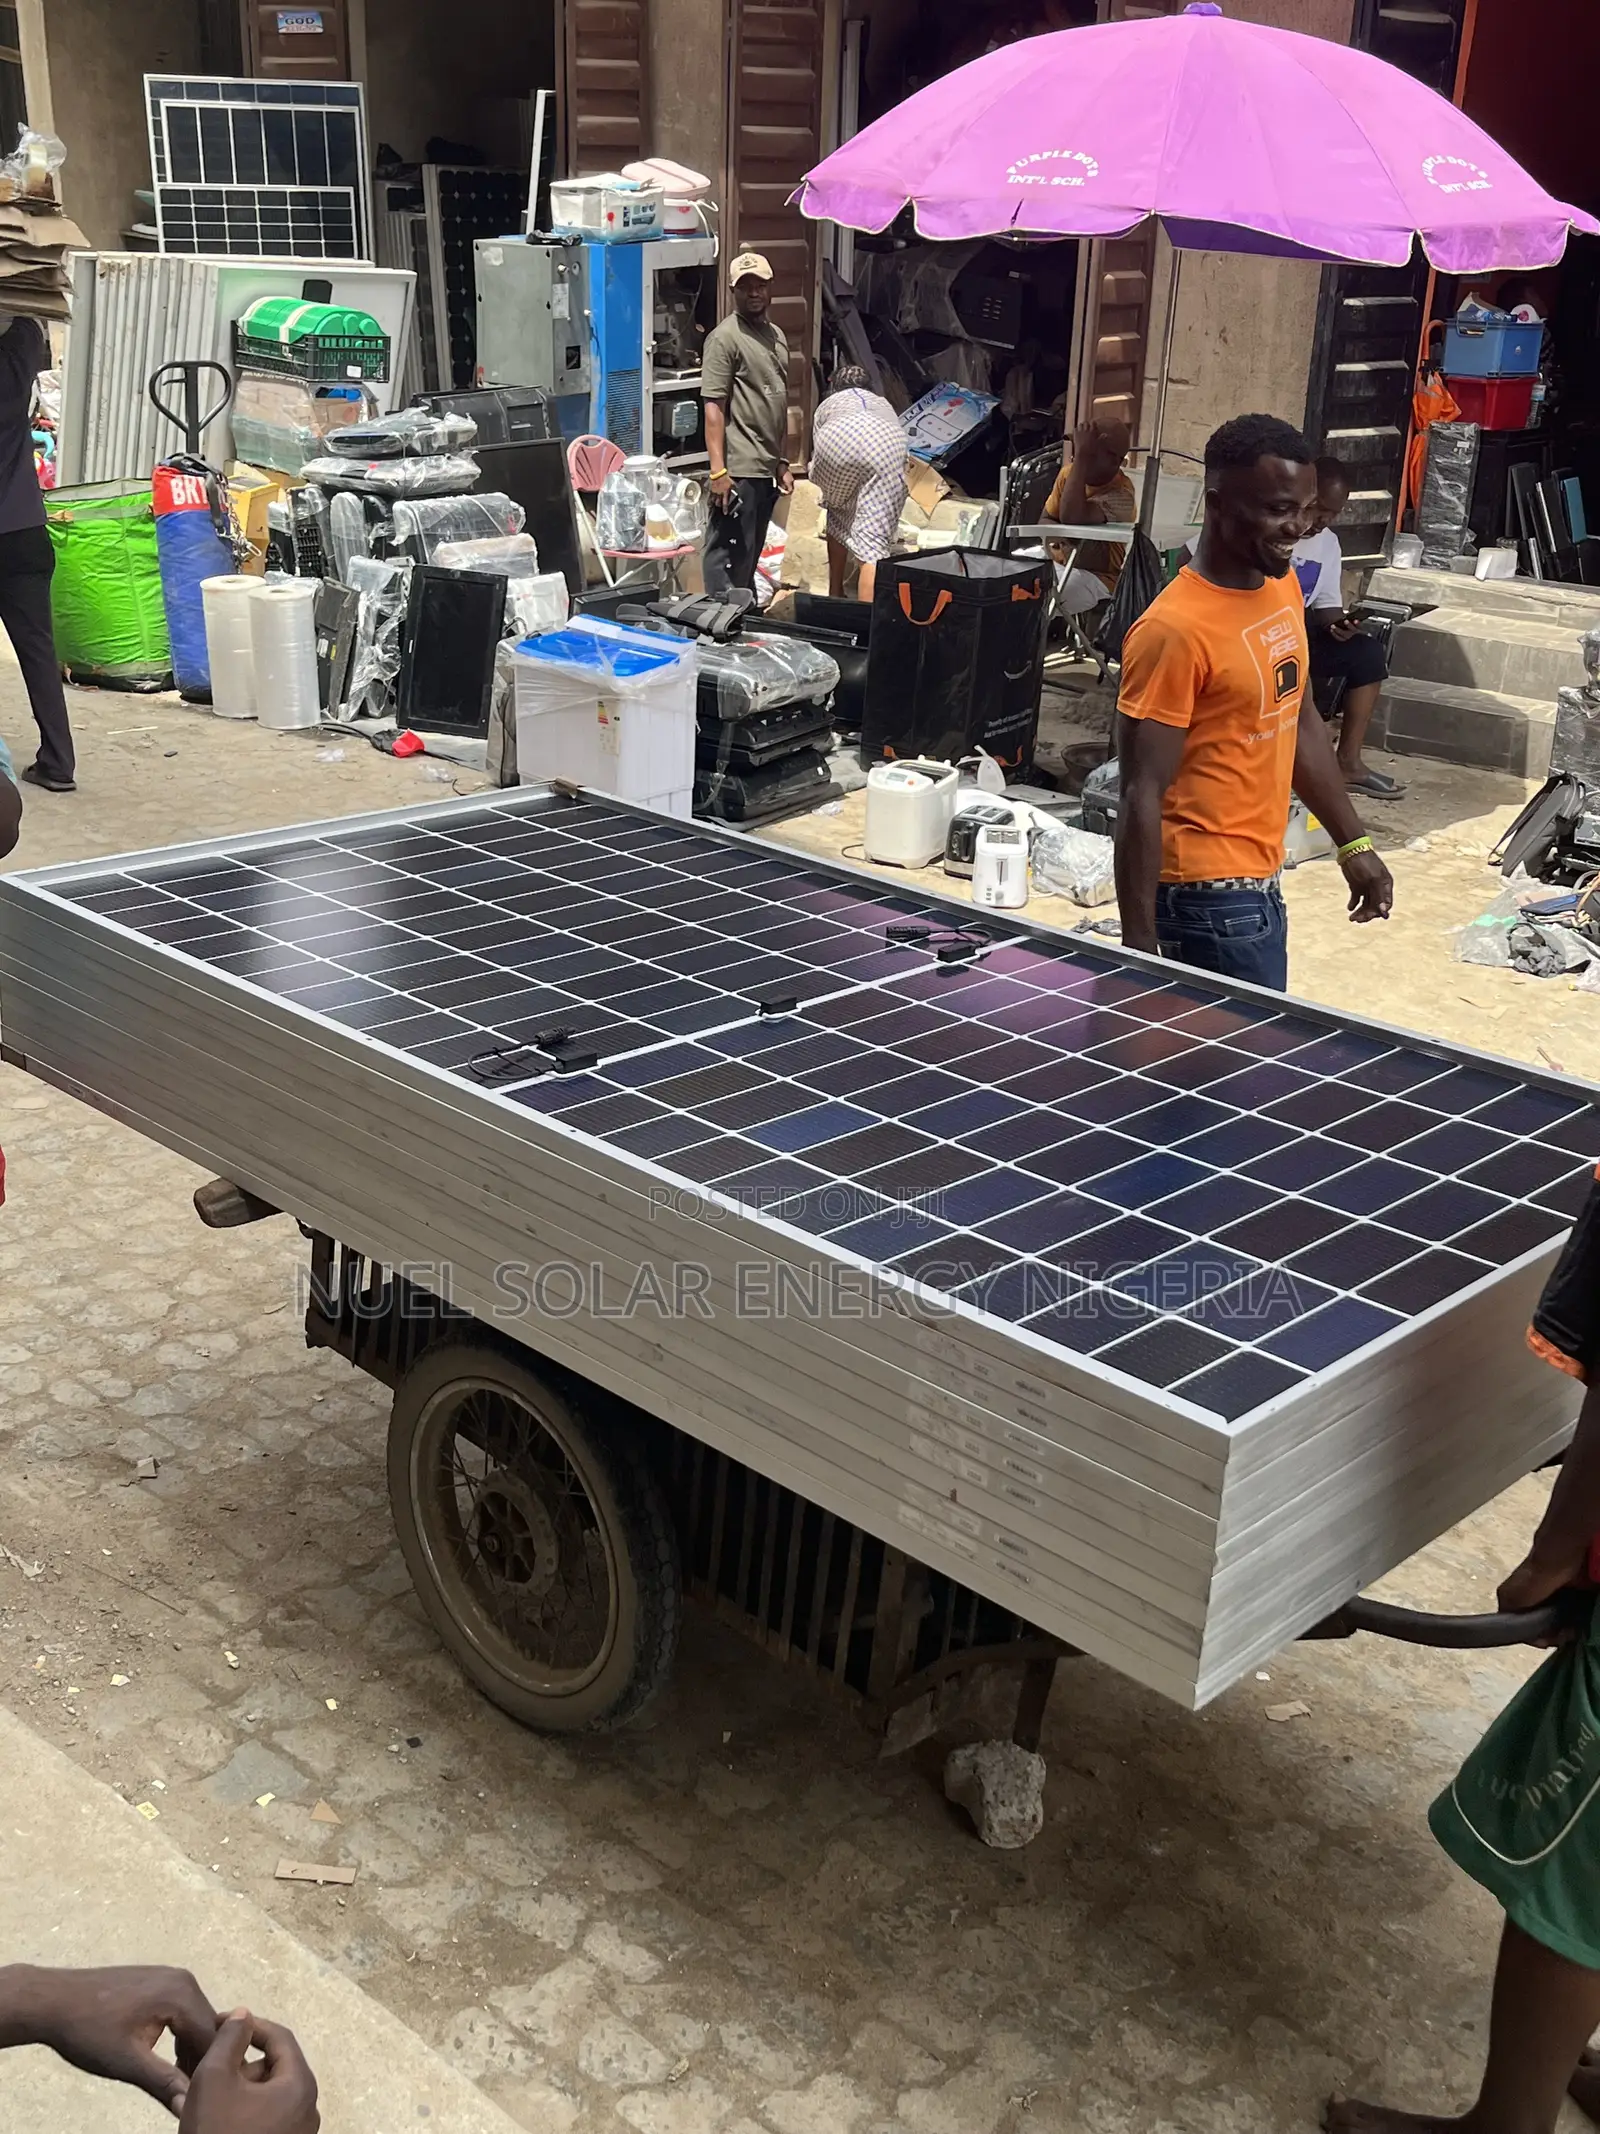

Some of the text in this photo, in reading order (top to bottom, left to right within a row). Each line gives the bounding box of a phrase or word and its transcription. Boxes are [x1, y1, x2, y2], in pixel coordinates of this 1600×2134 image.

[285, 17, 315, 25] GOD
[1006, 149, 1072, 174] PURPLE
[1260, 619, 1293, 646] NEW
